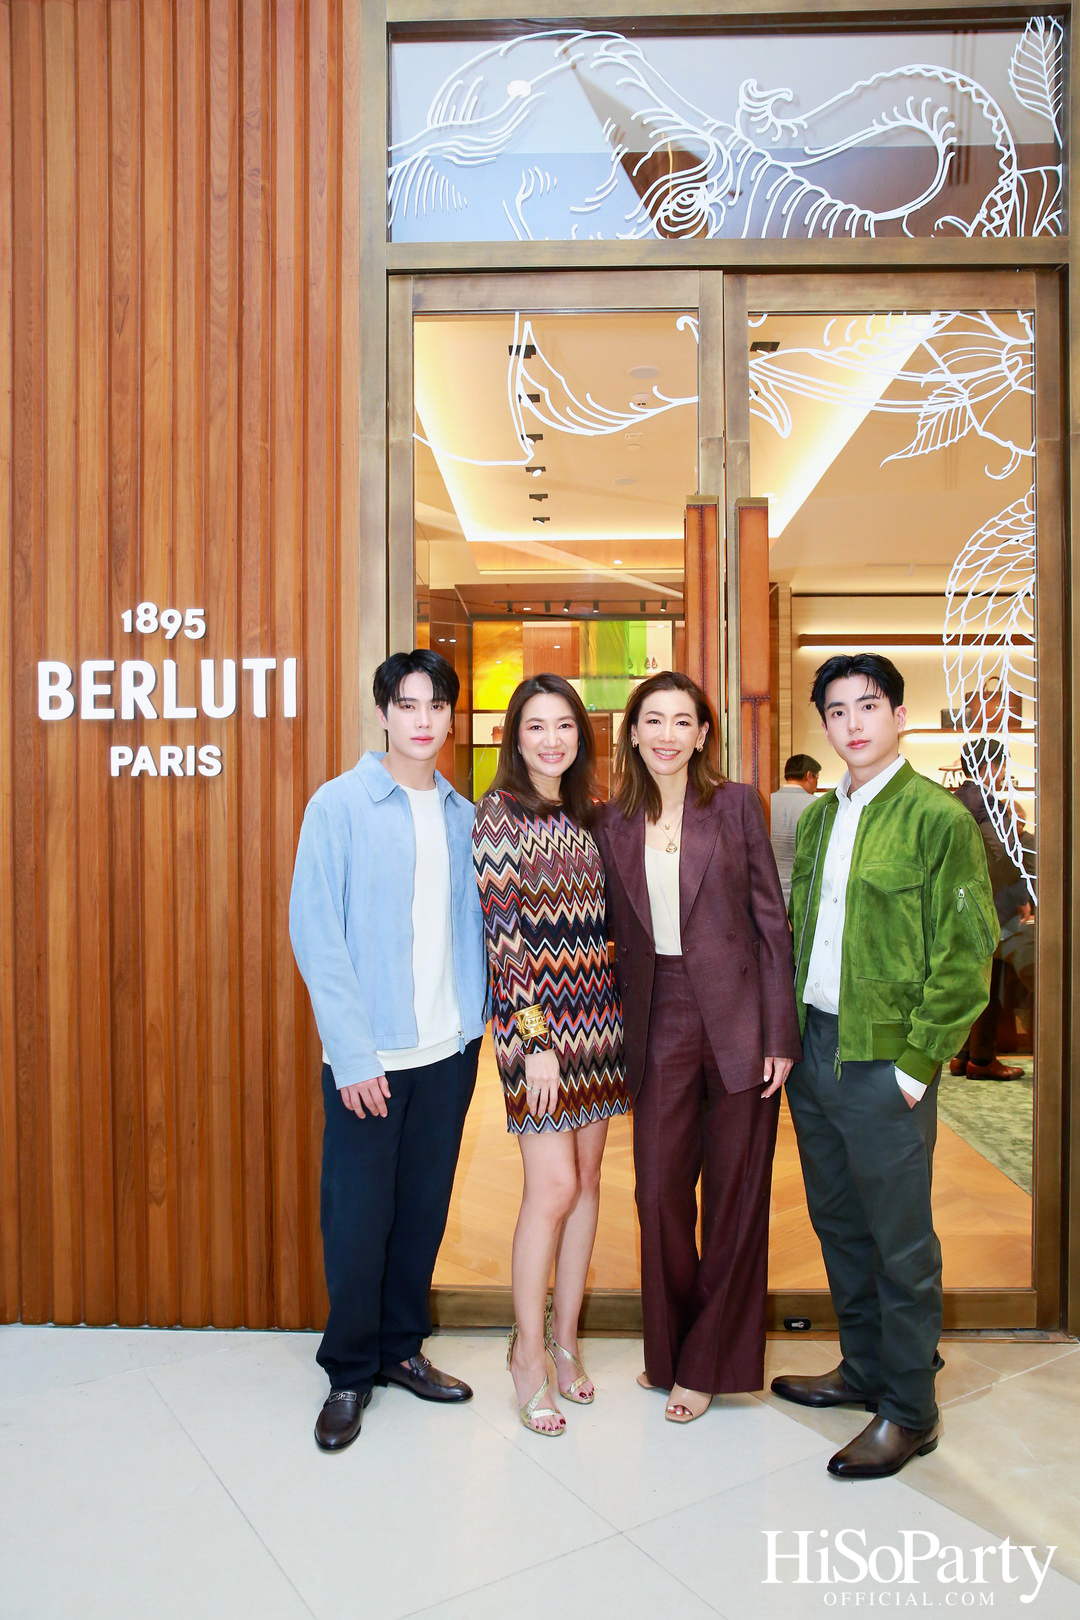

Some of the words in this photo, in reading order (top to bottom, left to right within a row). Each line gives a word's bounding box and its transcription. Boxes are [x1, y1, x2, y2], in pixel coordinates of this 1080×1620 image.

[121, 602, 206, 639] 1895
[37, 657, 297, 720] BERLUTI
[110, 744, 222, 777] PARIS
